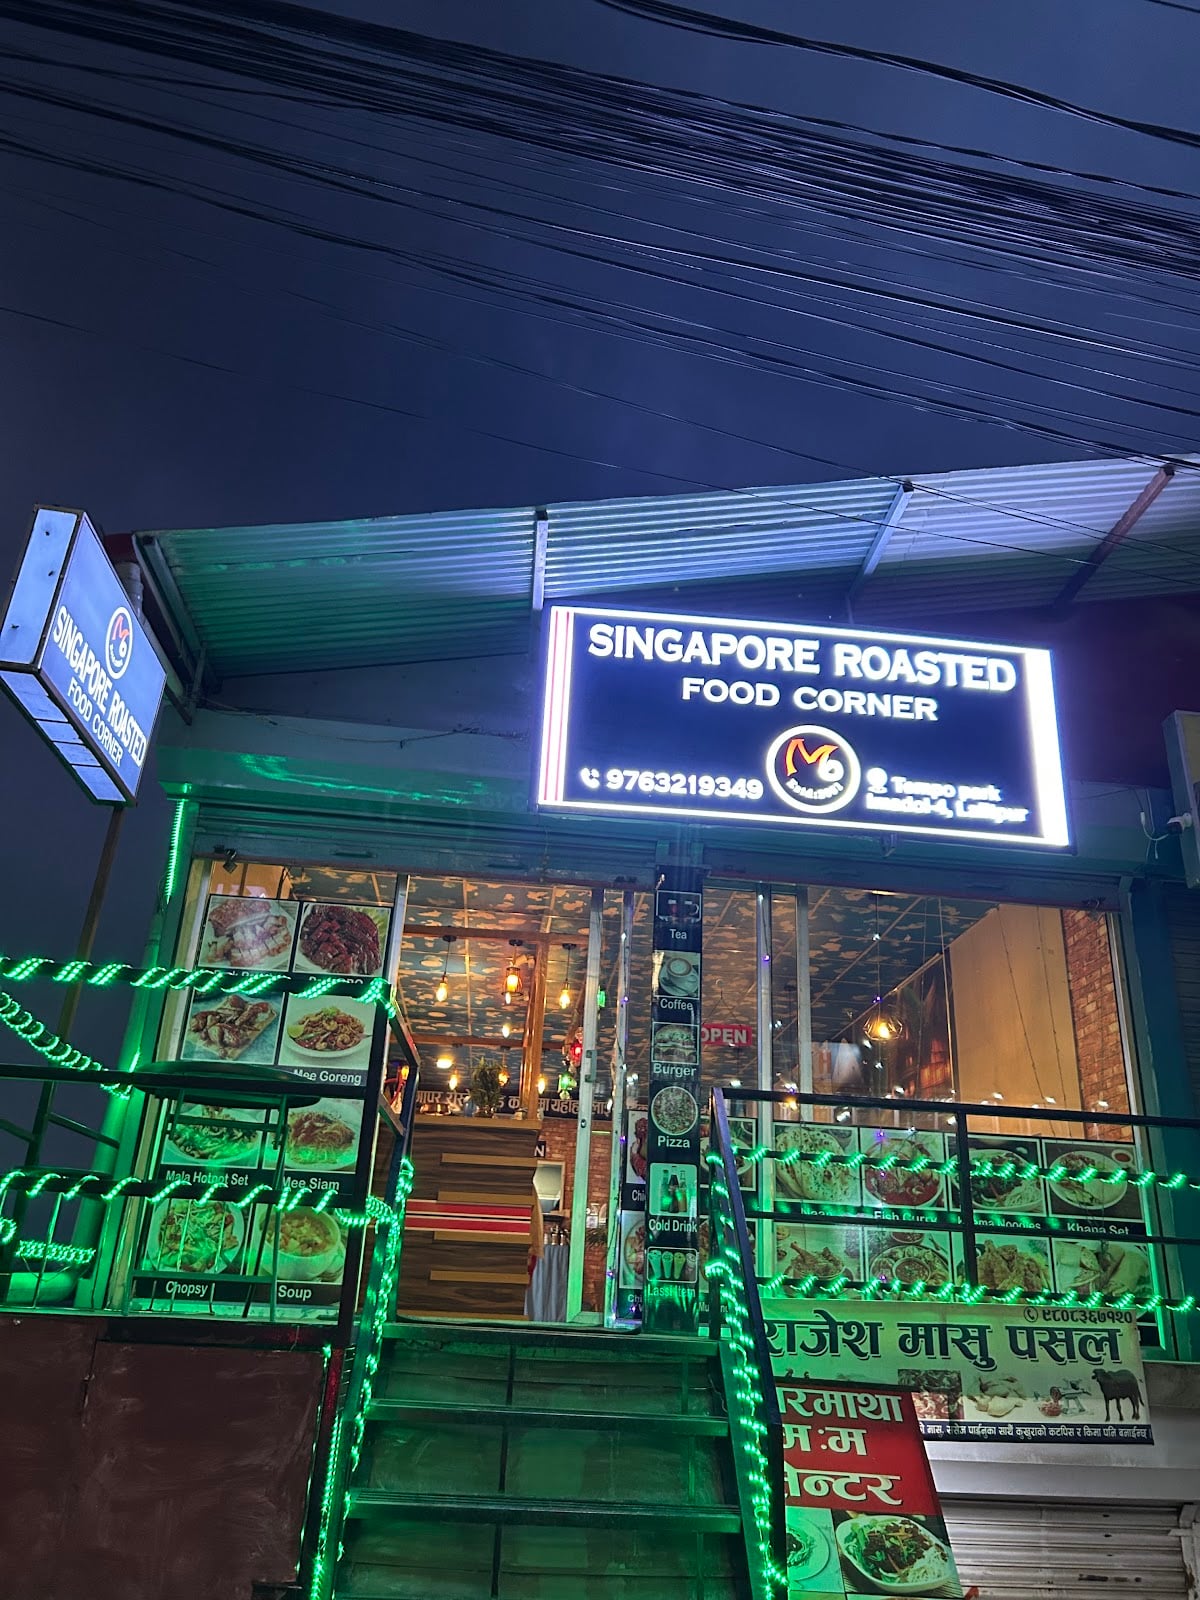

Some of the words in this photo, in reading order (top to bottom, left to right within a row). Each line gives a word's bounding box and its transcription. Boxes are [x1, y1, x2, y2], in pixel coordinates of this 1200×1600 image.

[588, 623, 820, 676] SINGAPORE
[834, 642, 1017, 692] ROASTED
[53, 605, 112, 715] SINGAPORE
[108, 690, 148, 767] ROASTED
[682, 677, 780, 707] FOOD
[793, 685, 939, 721] CORNER
[68, 676, 93, 722] FOOD
[92, 713, 124, 768] CORNER
[606, 768, 764, 800] 9763219349
[669, 928, 688, 940] Tea
[660, 998, 694, 1011] Coffee
[701, 1027, 747, 1044] OPEN
[319, 1070, 362, 1087] Goreng
[653, 1063, 697, 1078] Burger
[657, 1136, 691, 1149] Pizza
[165, 1169, 191, 1184] Mala
[230, 1173, 249, 1187] Set
[282, 1176, 306, 1190] Mee
[309, 1177, 341, 1191] Siam
[873, 1210, 900, 1221] Fish
[648, 1218, 670, 1232] Cold
[672, 1219, 698, 1233] Drink
[1109, 1225, 1130, 1236] Set
[165, 1280, 209, 1298] Chopsy
[278, 1284, 312, 1302] Soup
[763, 1309, 885, 1361] राजेश
[897, 1322, 998, 1372] मासु
[1005, 1325, 1124, 1366] पसल
[776, 1386, 904, 1422] रमाथा
